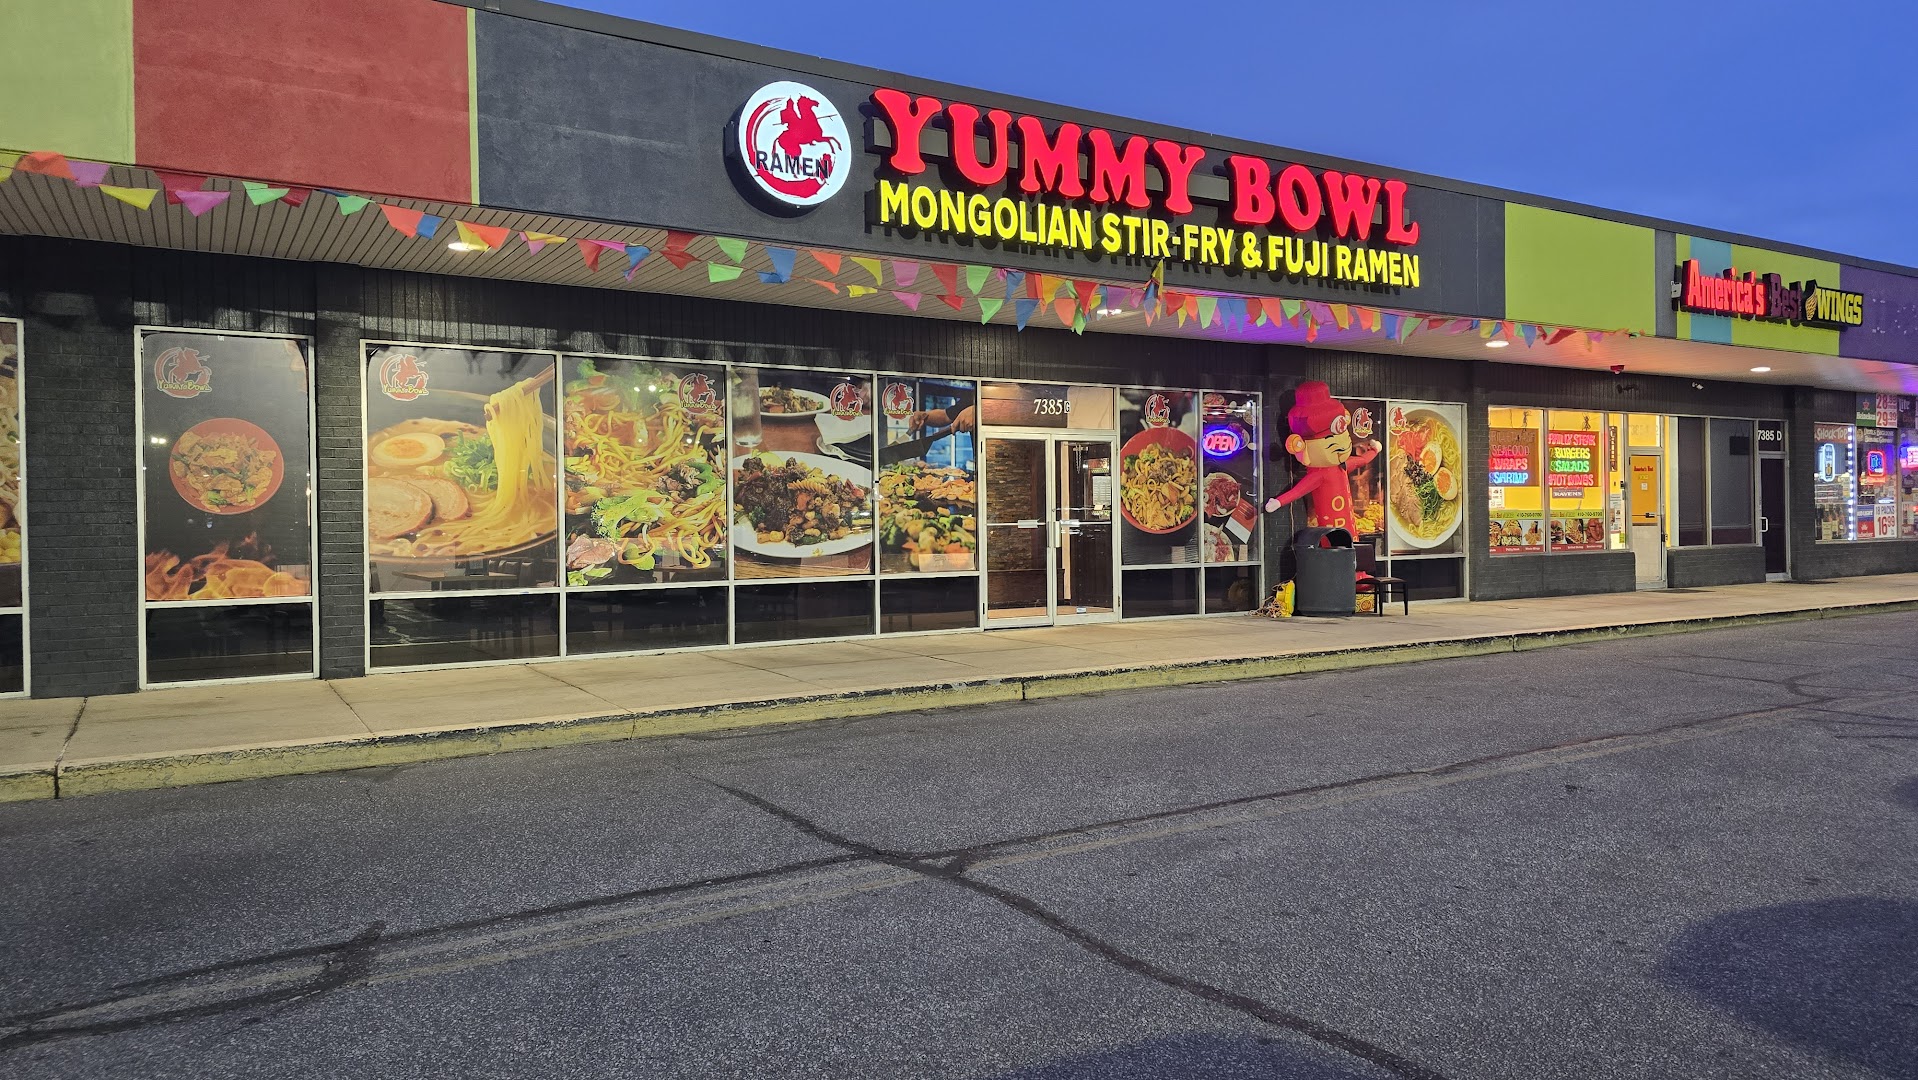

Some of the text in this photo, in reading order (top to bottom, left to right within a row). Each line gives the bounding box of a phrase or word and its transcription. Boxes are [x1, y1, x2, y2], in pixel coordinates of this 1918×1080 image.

[755, 150, 829, 179] RAMEN
[873, 88, 1420, 246] YUMMY BOWL
[880, 179, 1421, 289] MONGOLIAN STIR-FRY & FUJI RAMEN
[1686, 258, 1864, 325] America's Best WINGS
[1033, 398, 1063, 415] 7385
[1573, 433, 1596, 446] STEAK
[1757, 429, 1782, 441] 7385 D
[1204, 435, 1237, 451] OPEN
[1491, 444, 1530, 457] SEAFOOD
[1554, 447, 1591, 459] BURGERS
[1492, 458, 1528, 470] WRAPS
[1555, 460, 1590, 472] SALADS
[1492, 471, 1529, 484] SHRIMP
[1549, 473, 1594, 486] HOT WINGS
